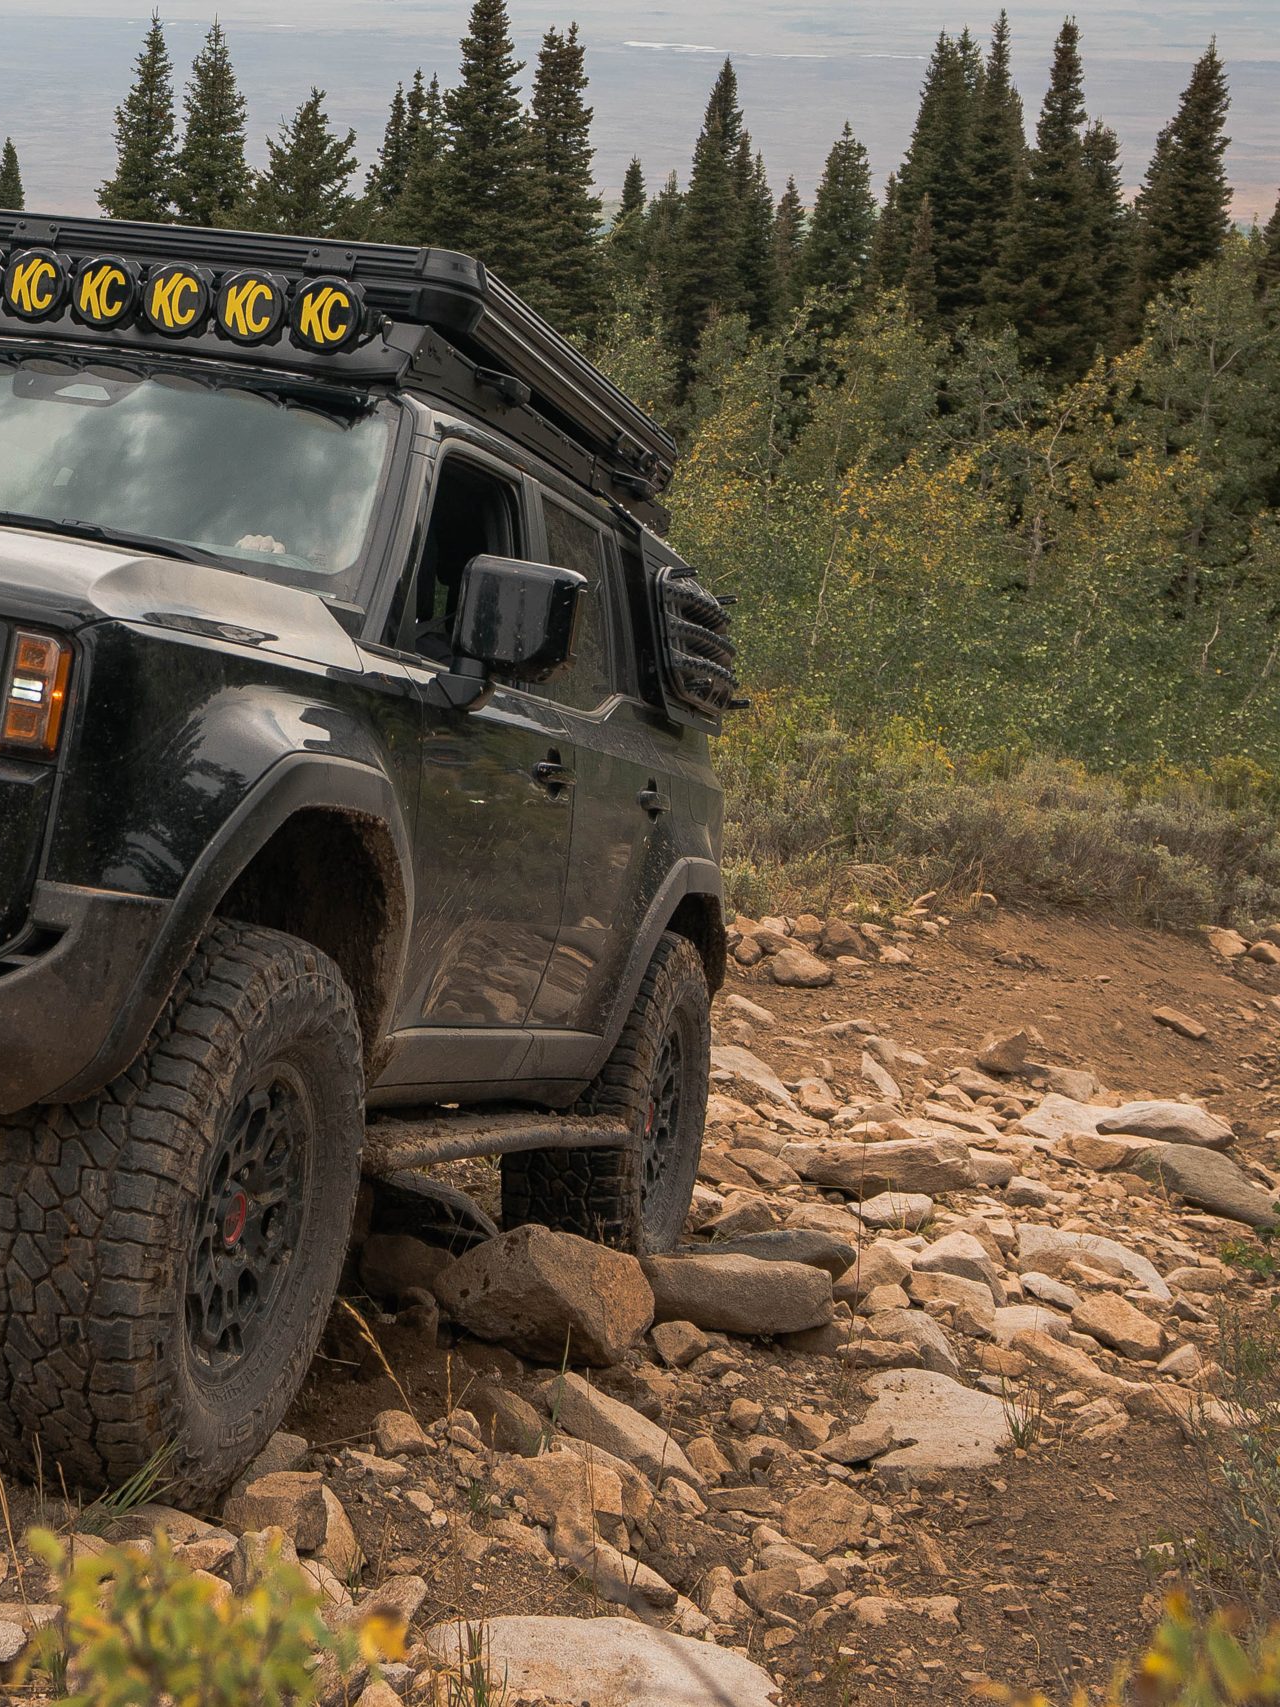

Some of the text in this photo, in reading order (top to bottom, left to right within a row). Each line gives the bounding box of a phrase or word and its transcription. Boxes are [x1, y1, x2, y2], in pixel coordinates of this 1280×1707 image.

[11, 258, 56, 312] KC
[80, 265, 125, 320] KC
[151, 272, 198, 328] KC
[224, 280, 273, 336] KC
[300, 287, 349, 344] KC
